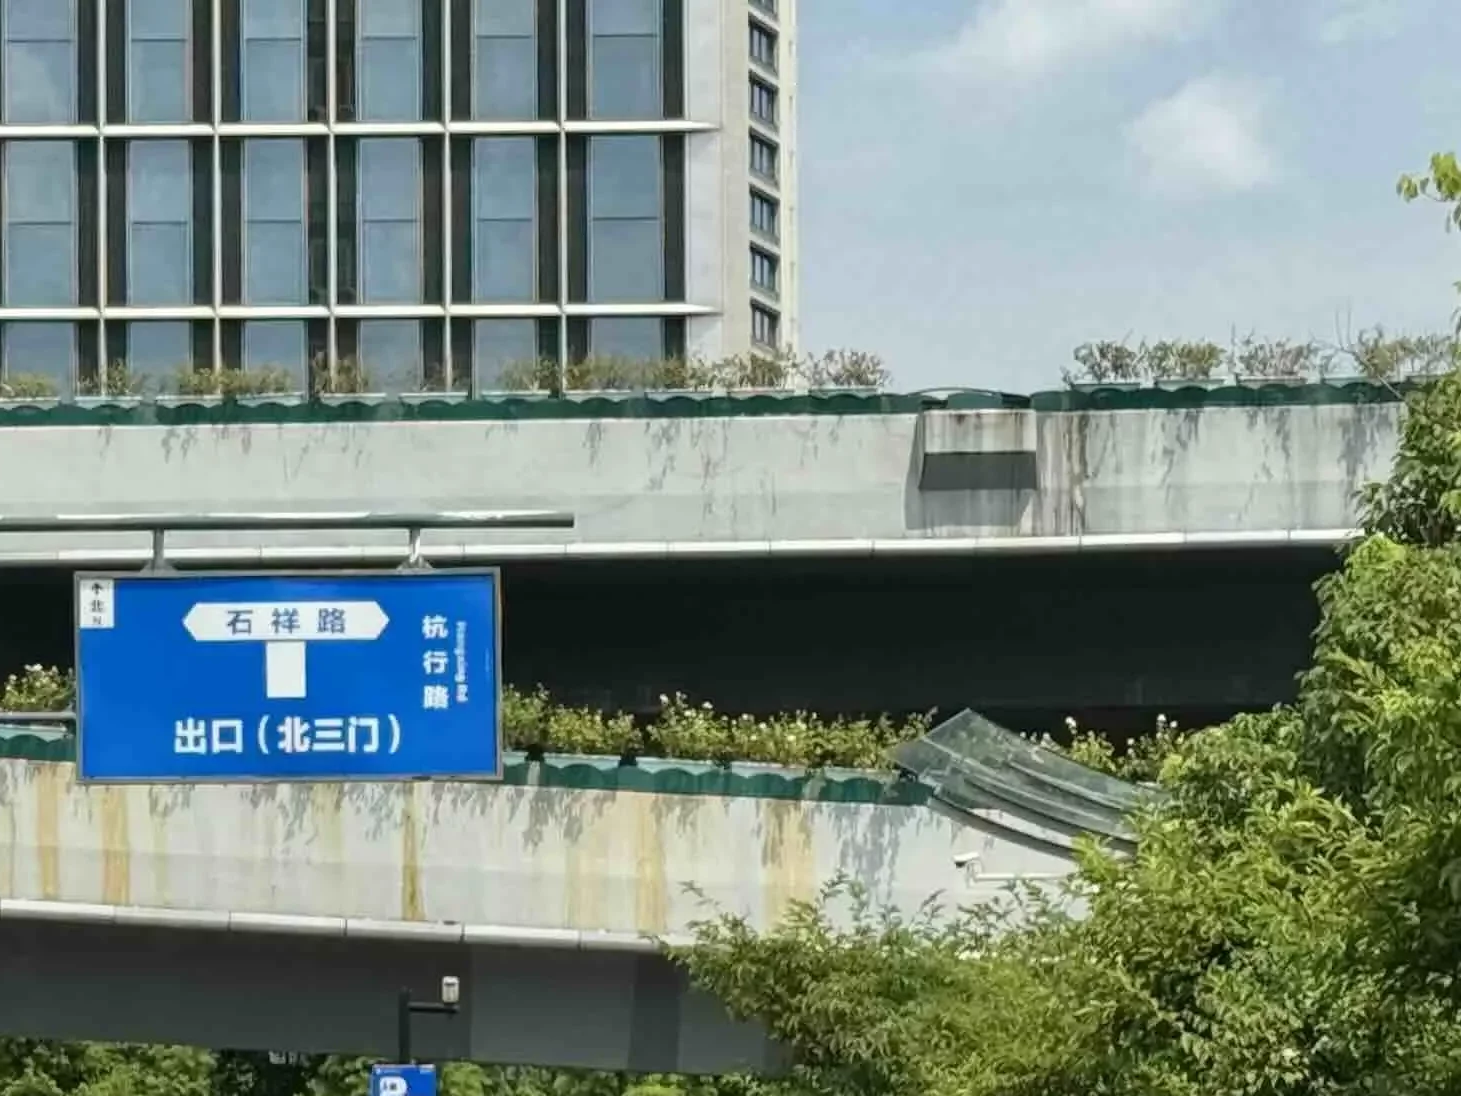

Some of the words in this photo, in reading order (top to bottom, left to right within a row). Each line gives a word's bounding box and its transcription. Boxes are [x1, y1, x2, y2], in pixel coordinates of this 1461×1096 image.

[226, 607, 346, 634] 石祥路
[422, 614, 449, 709] 杭行路
